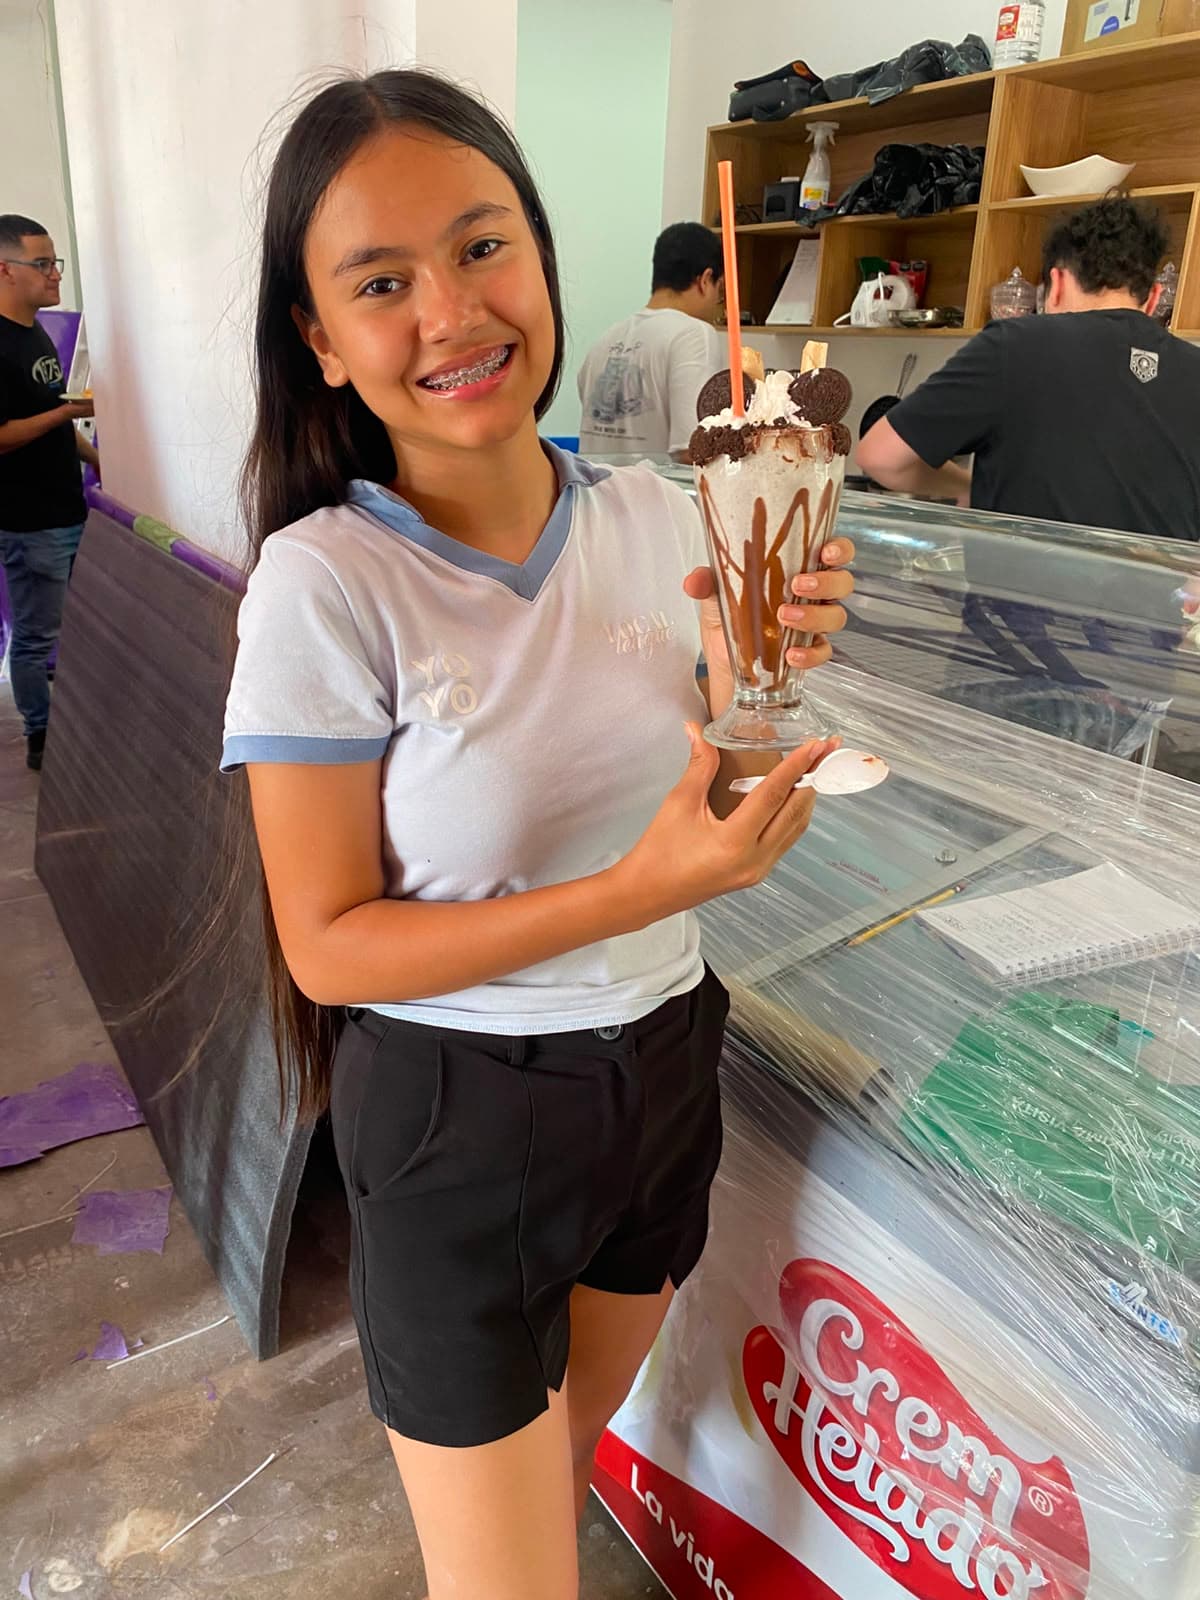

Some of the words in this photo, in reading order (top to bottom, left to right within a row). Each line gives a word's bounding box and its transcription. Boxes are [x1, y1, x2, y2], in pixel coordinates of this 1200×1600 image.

[420, 683, 478, 716] YO
[763, 1349, 1050, 1600] Helado
[800, 1298, 1022, 1535] Crem
[631, 1462, 663, 1525] La
[669, 1515, 735, 1600] vida
